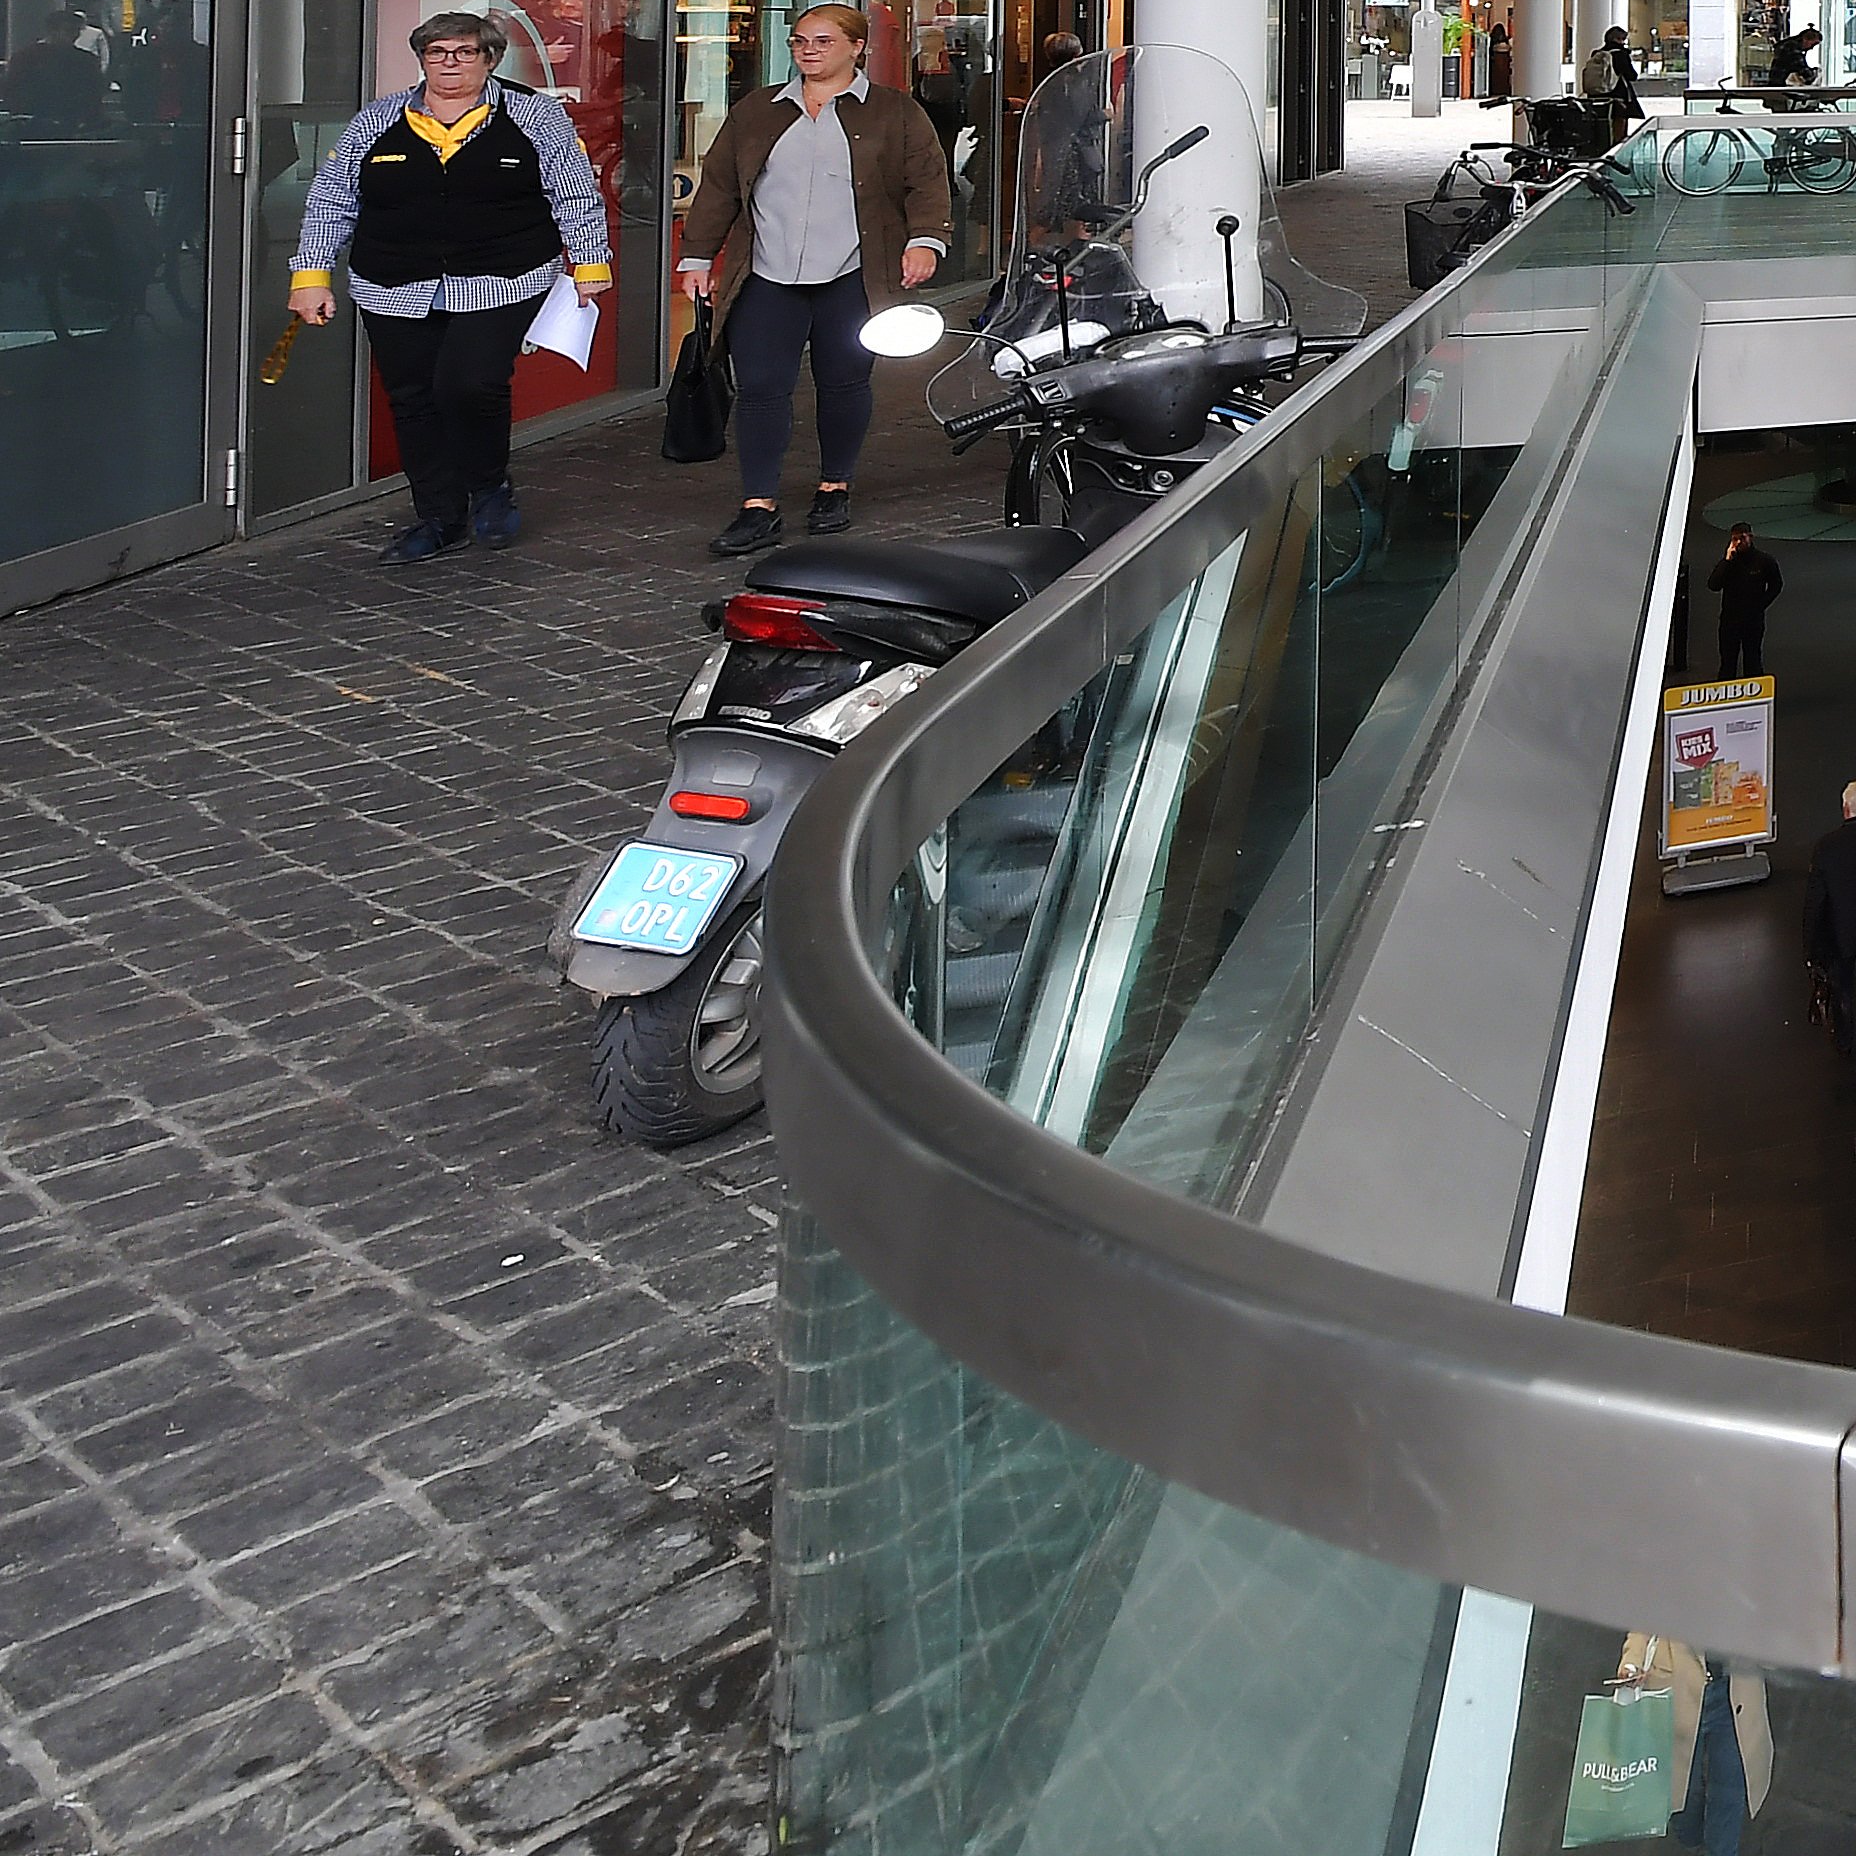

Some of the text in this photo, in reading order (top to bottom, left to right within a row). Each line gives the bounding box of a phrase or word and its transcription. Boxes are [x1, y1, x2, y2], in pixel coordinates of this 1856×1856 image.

[1680, 680, 1764, 706] JUMBO
[1682, 741, 1713, 761] MIX
[641, 857, 721, 902] D62
[1582, 1756, 1659, 1783] PULL&BEAR
